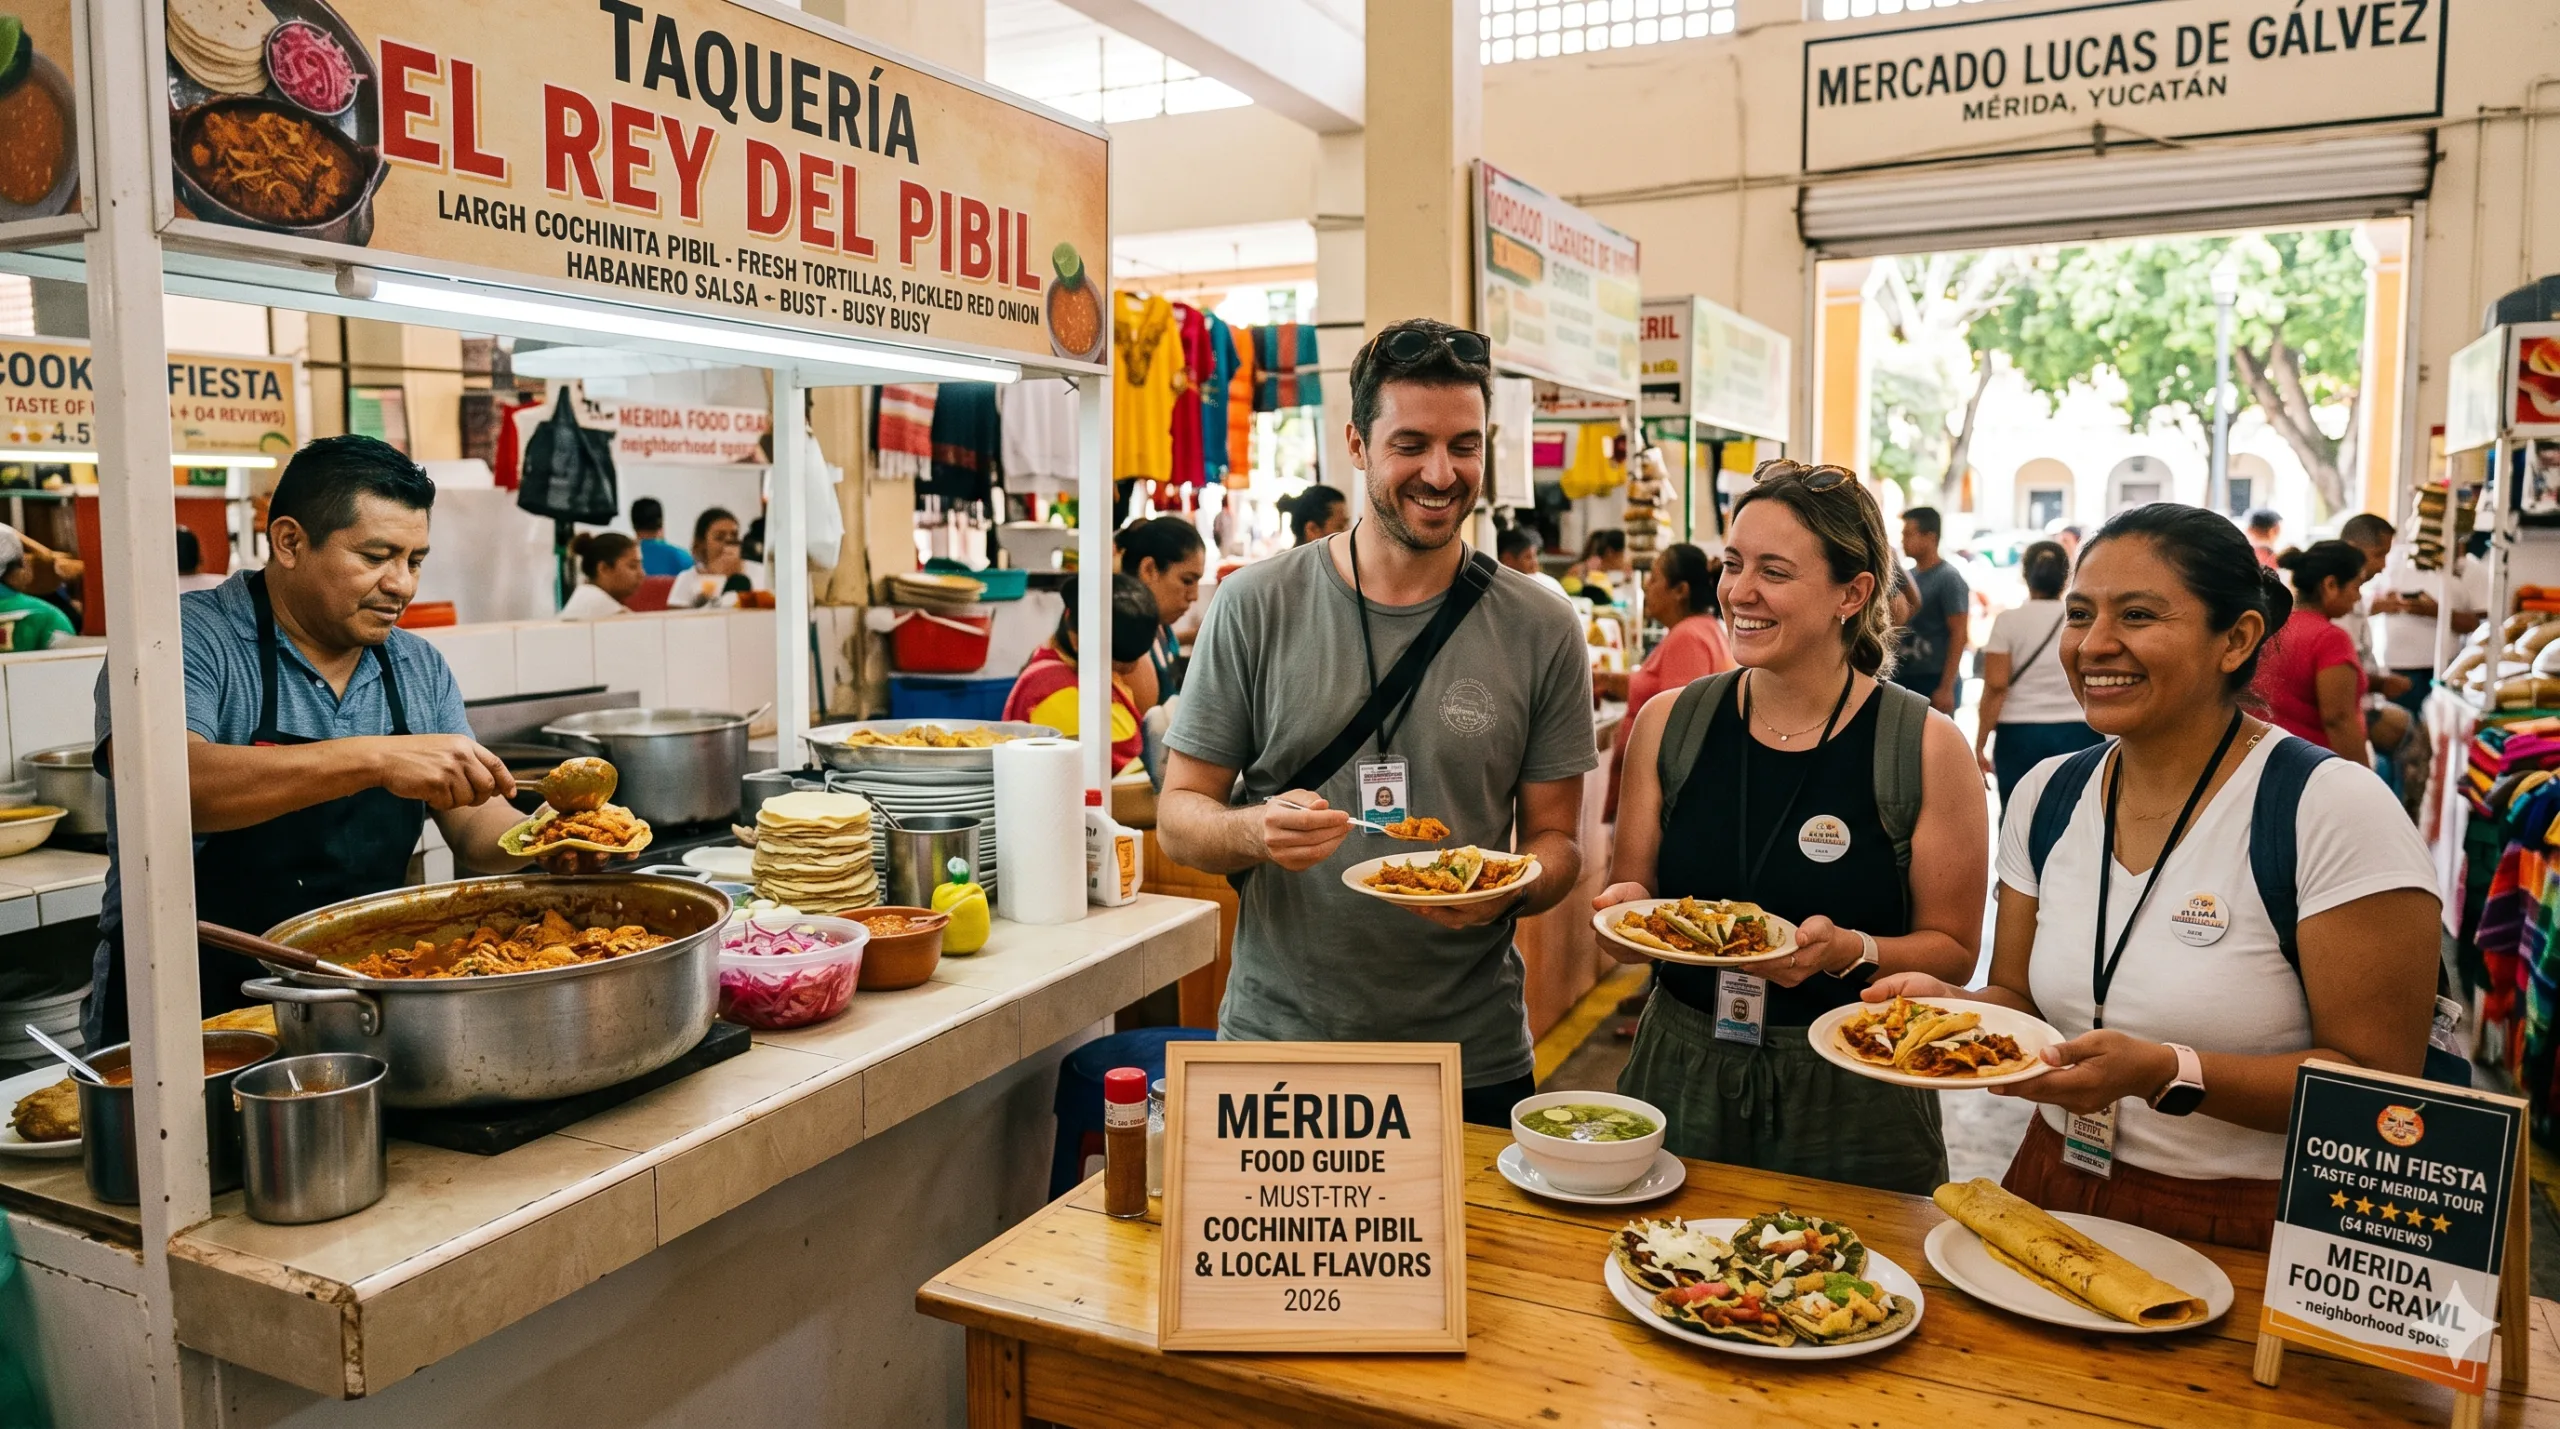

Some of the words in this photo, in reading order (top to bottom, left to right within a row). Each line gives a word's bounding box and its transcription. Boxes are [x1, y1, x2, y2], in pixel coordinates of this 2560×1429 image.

[1818, 48, 2007, 108] MERCADO
[2024, 29, 2157, 84] LUCAS
[2176, 21, 2230, 67] DE
[2249, 0, 2428, 60] GÁLVEZ
[599, 0, 920, 165] TAQUERÍA
[1962, 91, 2077, 122] MÉRIDA,
[2088, 69, 2228, 109] YUCATÁN
[379, 37, 507, 182] EL
[542, 81, 717, 223] REY
[745, 136, 877, 259] DEL
[898, 178, 1043, 294] PIBIL
[438, 189, 526, 233] LARGH
[535, 209, 660, 257] COCHINITA
[667, 234, 720, 268] PIBIL
[737, 248, 797, 282] FRESH
[802, 261, 897, 303] TORTILLAS,
[902, 280, 963, 311] PICKLED
[967, 294, 994, 317] RED
[998, 301, 1040, 326] ONION
[567, 251, 688, 295] HABANERO
[695, 274, 758, 307] SALSA
[780, 288, 827, 318] BUST
[843, 299, 886, 327] BUSY
[890, 309, 931, 334] BUSY
[0, 351, 93, 391] OOK
[168, 363, 282, 401] FIESTA
[5, 396, 59, 414] TASTE
[65, 399, 85, 415] OF
[619, 406, 682, 429] MERIDA
[687, 408, 729, 431] FOOD
[1217, 1081, 1411, 1139] MÉRIDA
[1241, 1149, 1305, 1173] FOOD
[1312, 1149, 1385, 1173] GUIDE
[2306, 1136, 2371, 1168] COOK
[2375, 1151, 2400, 1174] IN
[2406, 1158, 2488, 1194] FIESTA
[1260, 1185, 1372, 1208] MUST-TRY
[2311, 1164, 2355, 1186] TASTE
[2359, 1175, 2378, 1192] OF
[2380, 1181, 2439, 1205] MERIDA
[2442, 1193, 2485, 1214] TOUR
[1203, 1216, 1348, 1242] COCHINITA
[1355, 1217, 1423, 1242] PIBIL
[2339, 1215, 2362, 1233] (54
[2365, 1223, 2433, 1252] REVIEWS)
[1195, 1251, 1213, 1277] &
[1222, 1251, 1305, 1277] LOCAL
[1313, 1251, 1431, 1277] FLAVORS
[2326, 1243, 2433, 1292] MERIDA
[1284, 1289, 1341, 1312] 2026
[2288, 1263, 2360, 1302] FOOD
[2368, 1284, 2466, 1332] CRAWL
[2305, 1300, 2404, 1336] neighborhood
[2407, 1329, 2449, 1349] spots
